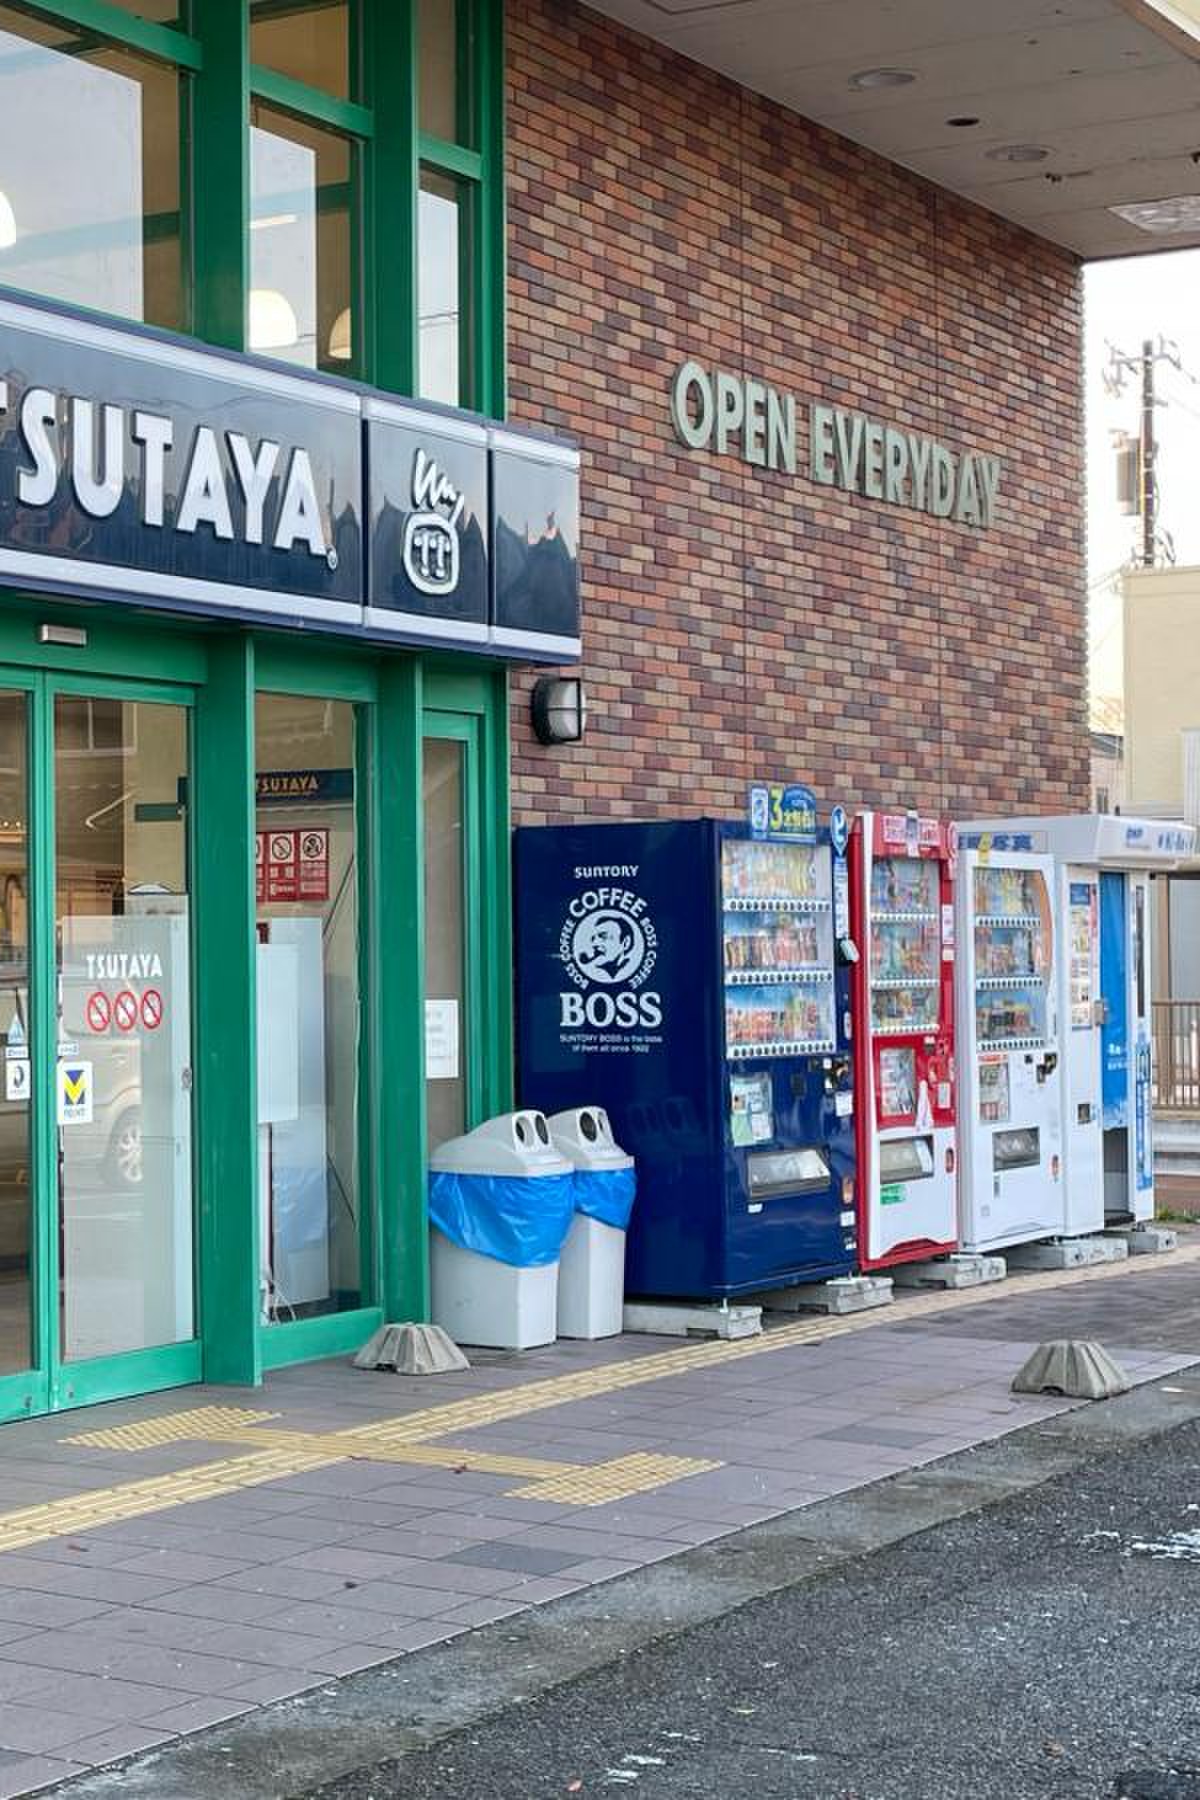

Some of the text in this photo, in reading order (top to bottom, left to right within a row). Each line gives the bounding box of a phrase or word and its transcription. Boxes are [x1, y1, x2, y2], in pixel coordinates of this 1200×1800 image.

[673, 360, 1001, 528] OPEN EVERYDAY
[256, 776, 319, 794] SUTAYA
[574, 864, 640, 880] SUNTORY
[568, 887, 648, 919] COFFEE
[86, 953, 163, 979] TSUTAYA
[559, 991, 663, 1029] BOSS
